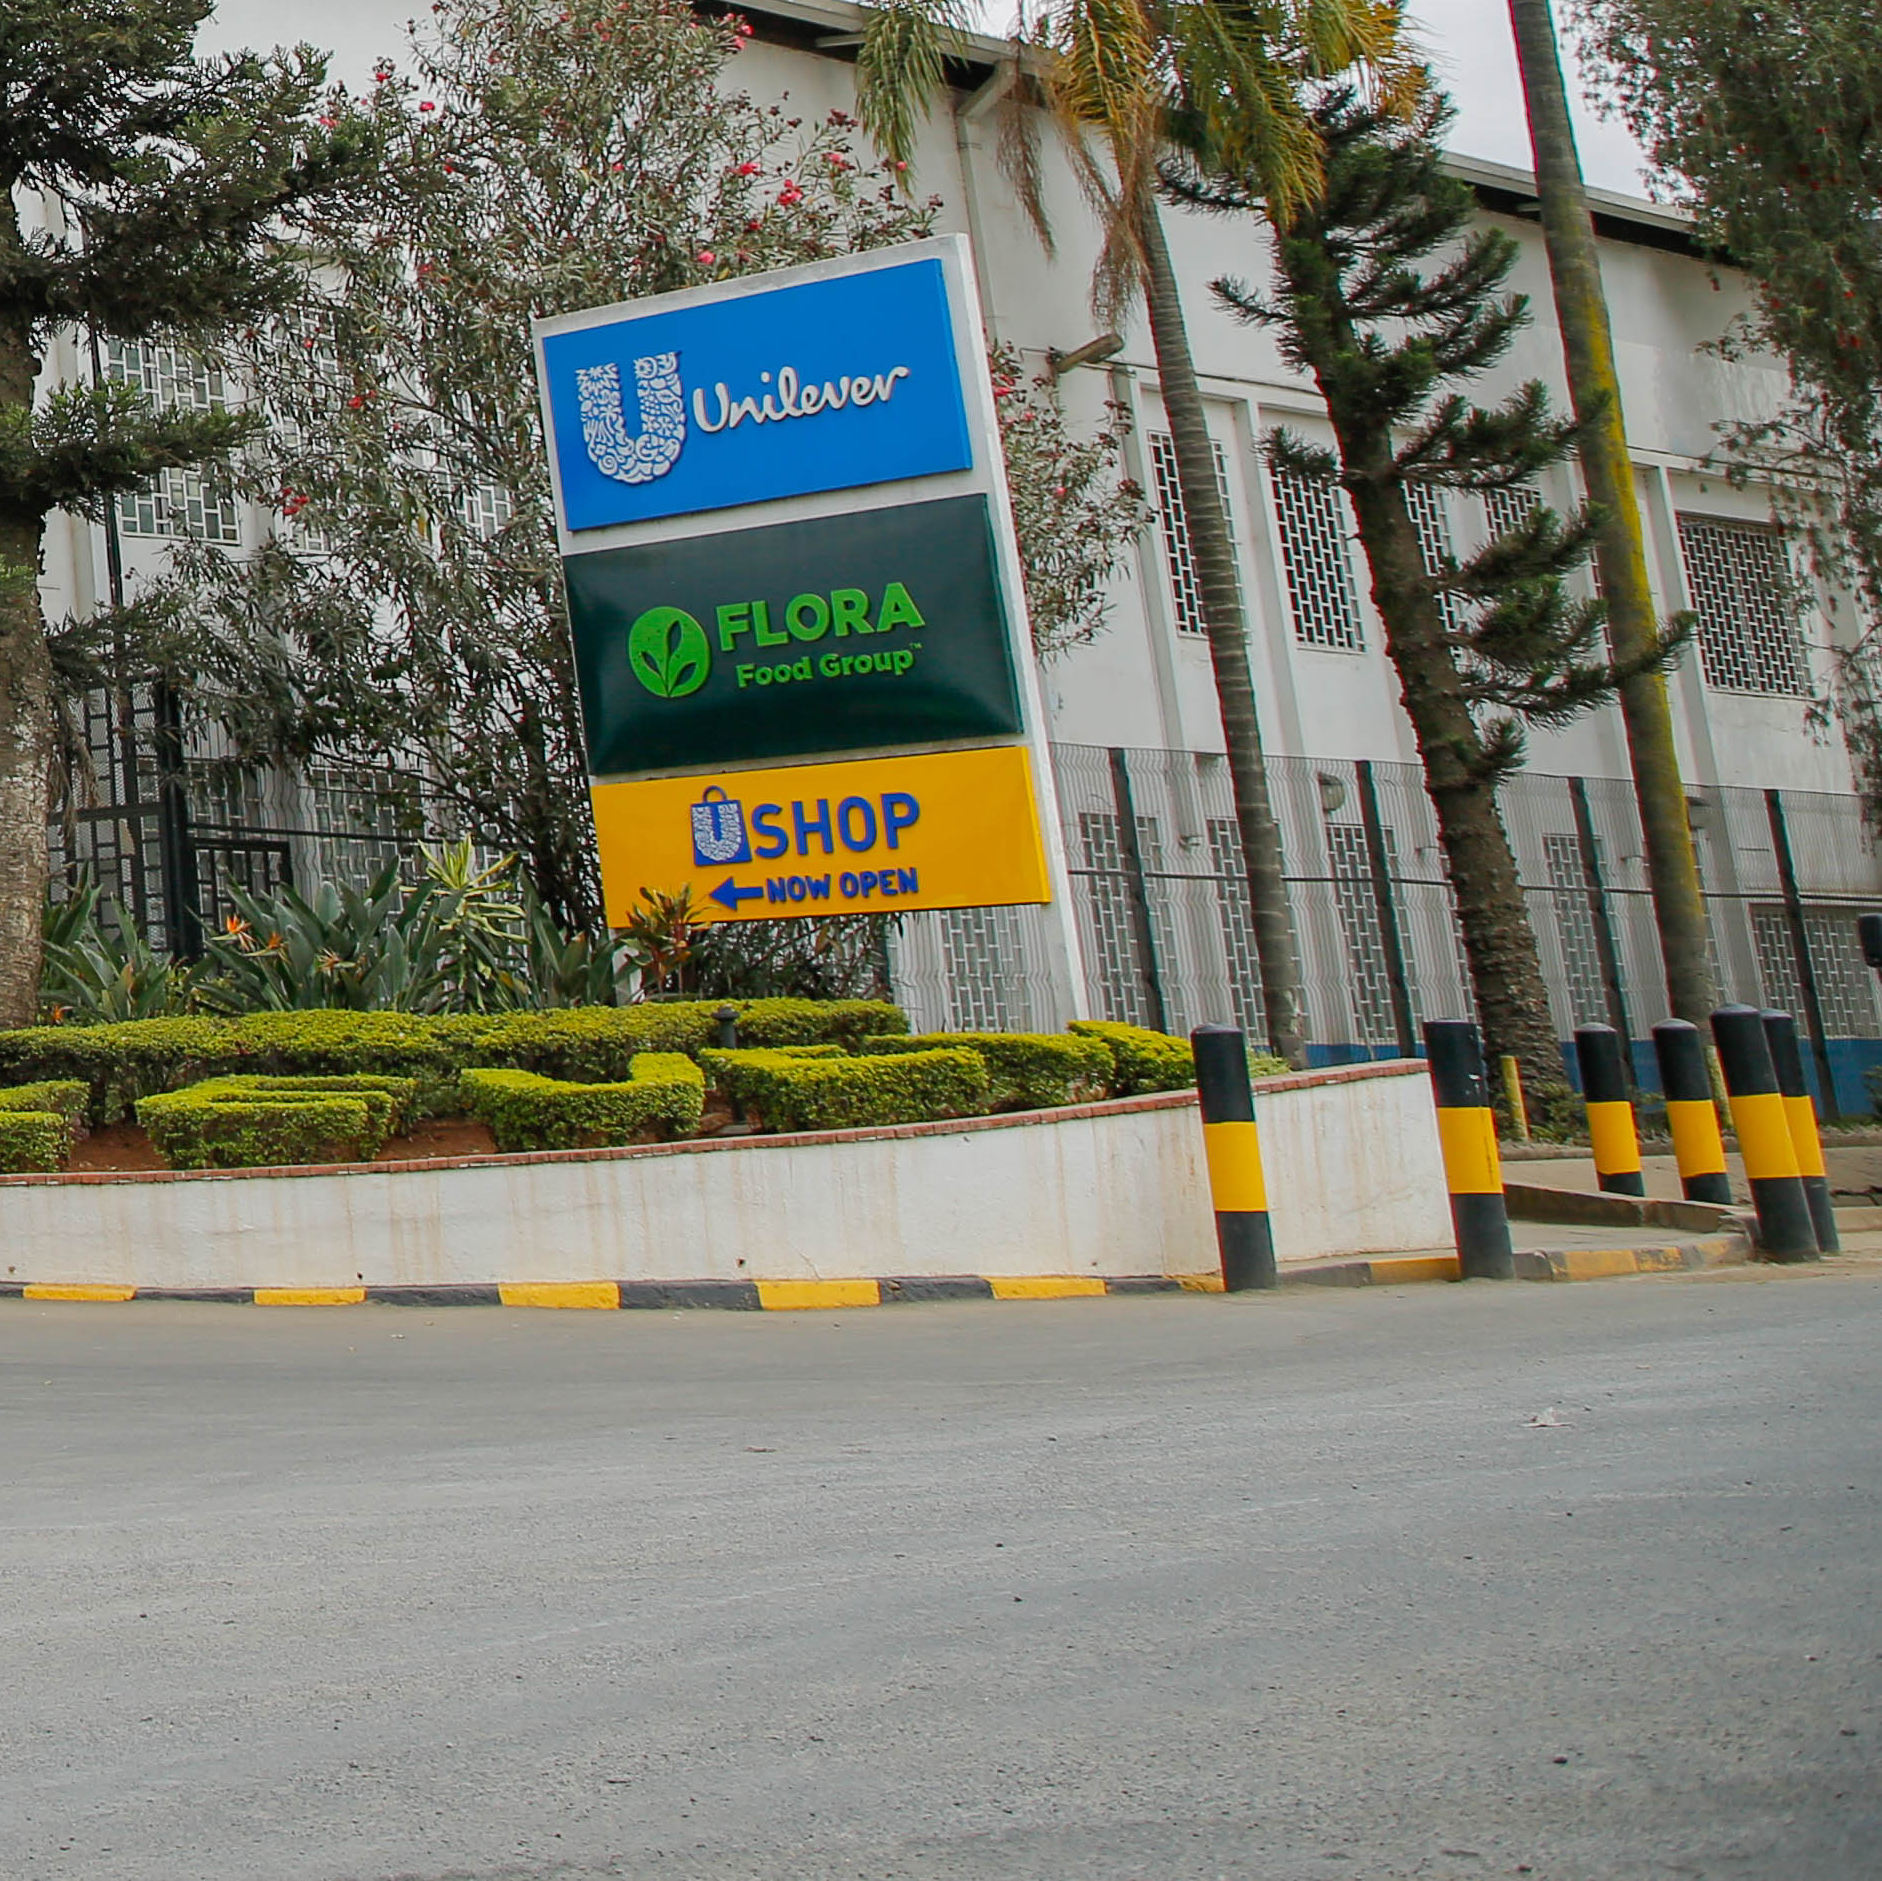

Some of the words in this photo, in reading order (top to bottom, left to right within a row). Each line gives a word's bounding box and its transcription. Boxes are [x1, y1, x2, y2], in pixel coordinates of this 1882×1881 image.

[693, 366, 911, 433] Unilever
[716, 582, 926, 652] FLORA
[736, 656, 813, 689] Food
[766, 873, 831, 903] NOW
[839, 867, 919, 898] OPEN
